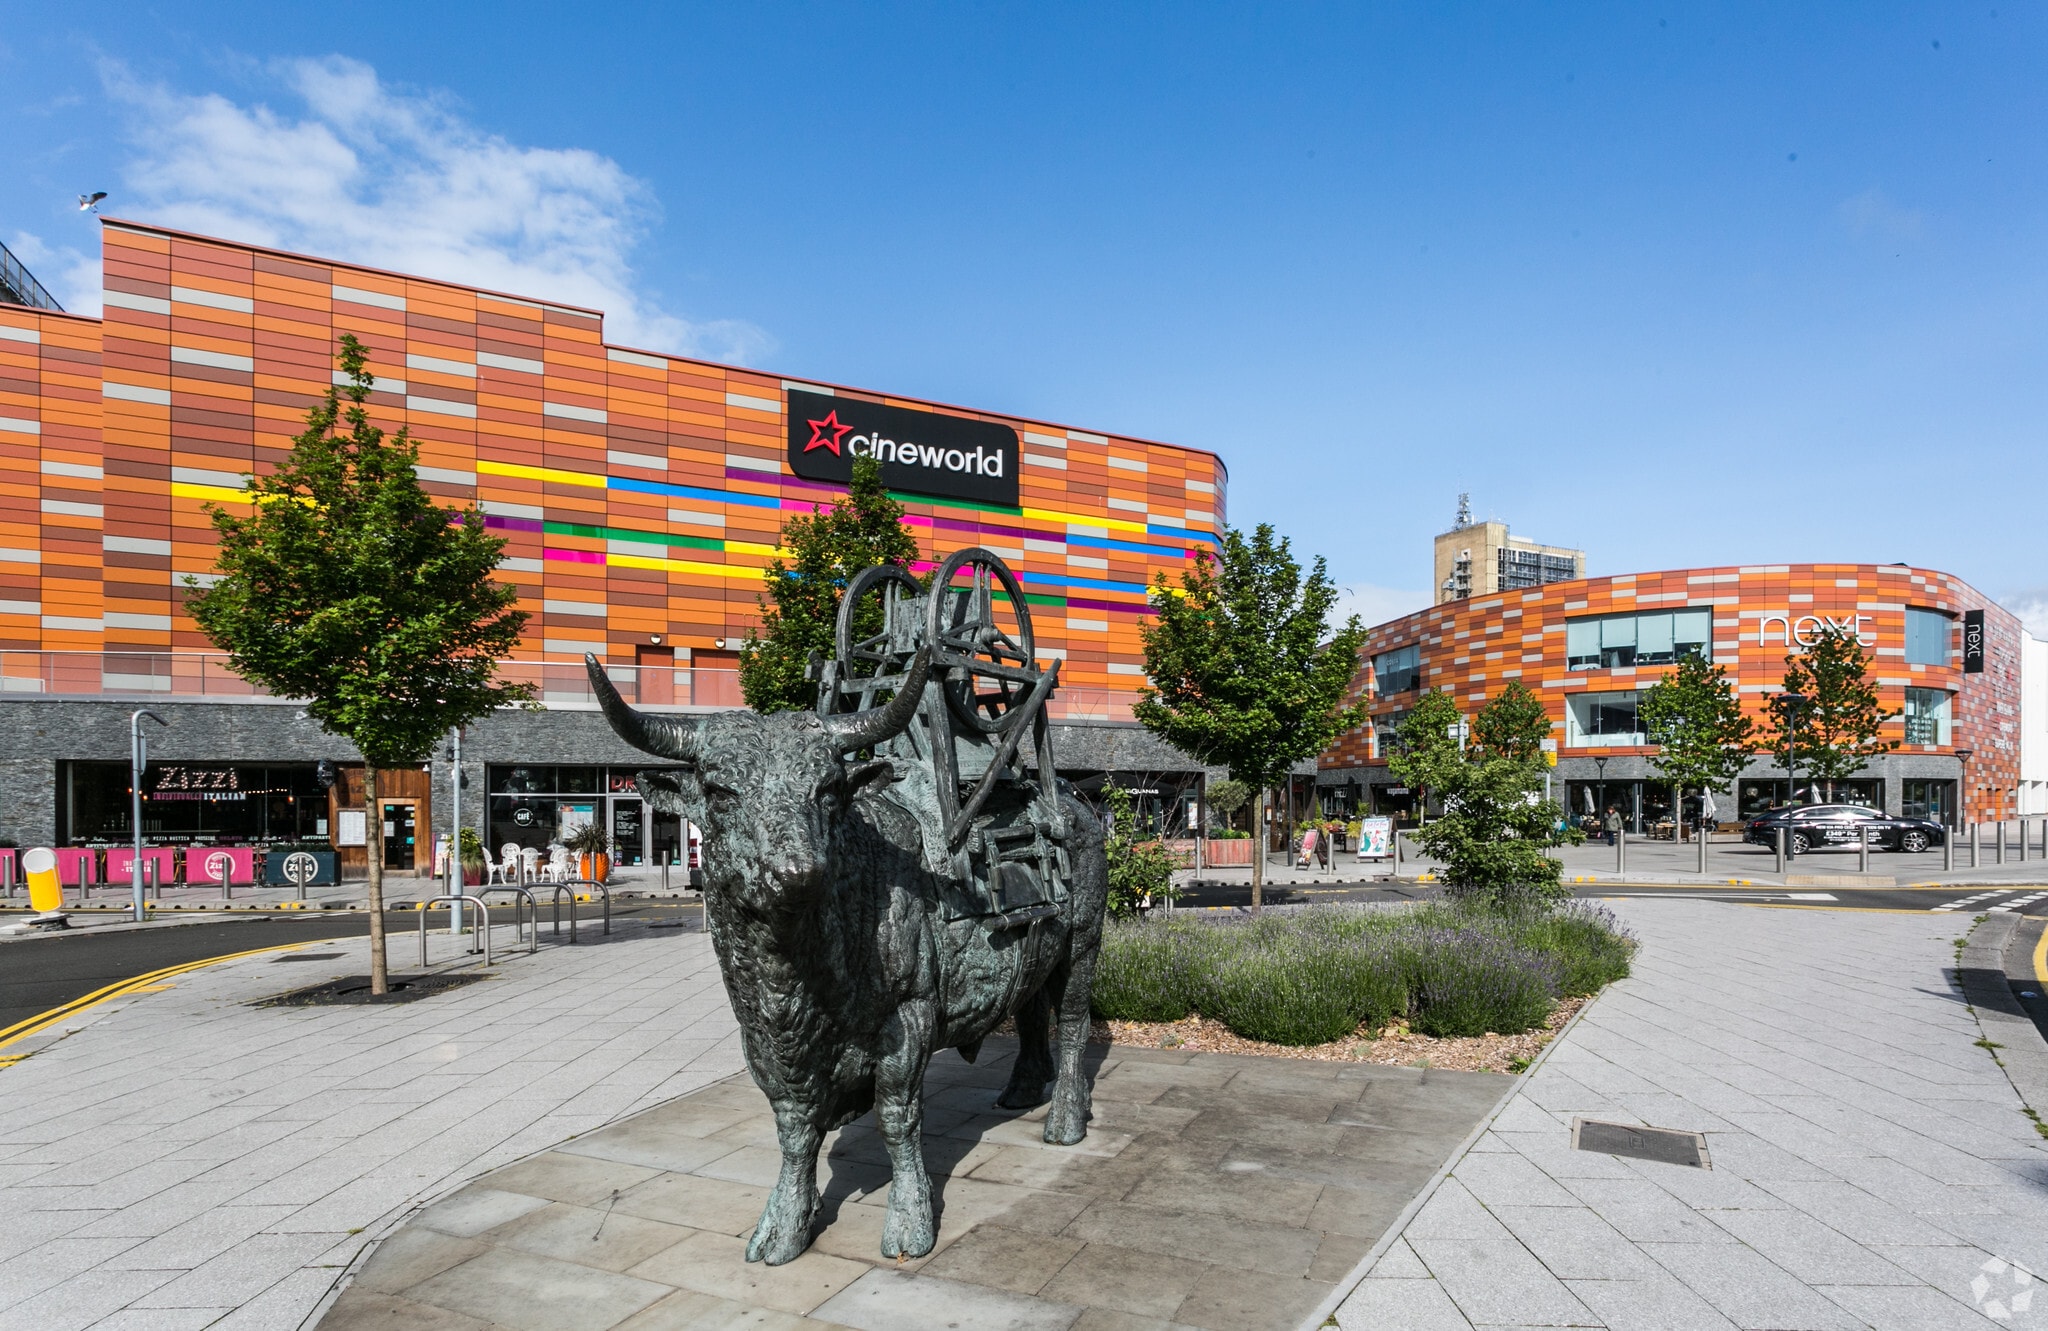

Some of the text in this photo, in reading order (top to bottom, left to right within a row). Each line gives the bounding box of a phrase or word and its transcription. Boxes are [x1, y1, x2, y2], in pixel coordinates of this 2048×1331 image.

[847, 432, 1003, 478] cineworld
[1759, 613, 1874, 648] next
[1967, 624, 1981, 658] next
[156, 767, 238, 790] Zizzi
[204, 792, 246, 800] ITALIAN
